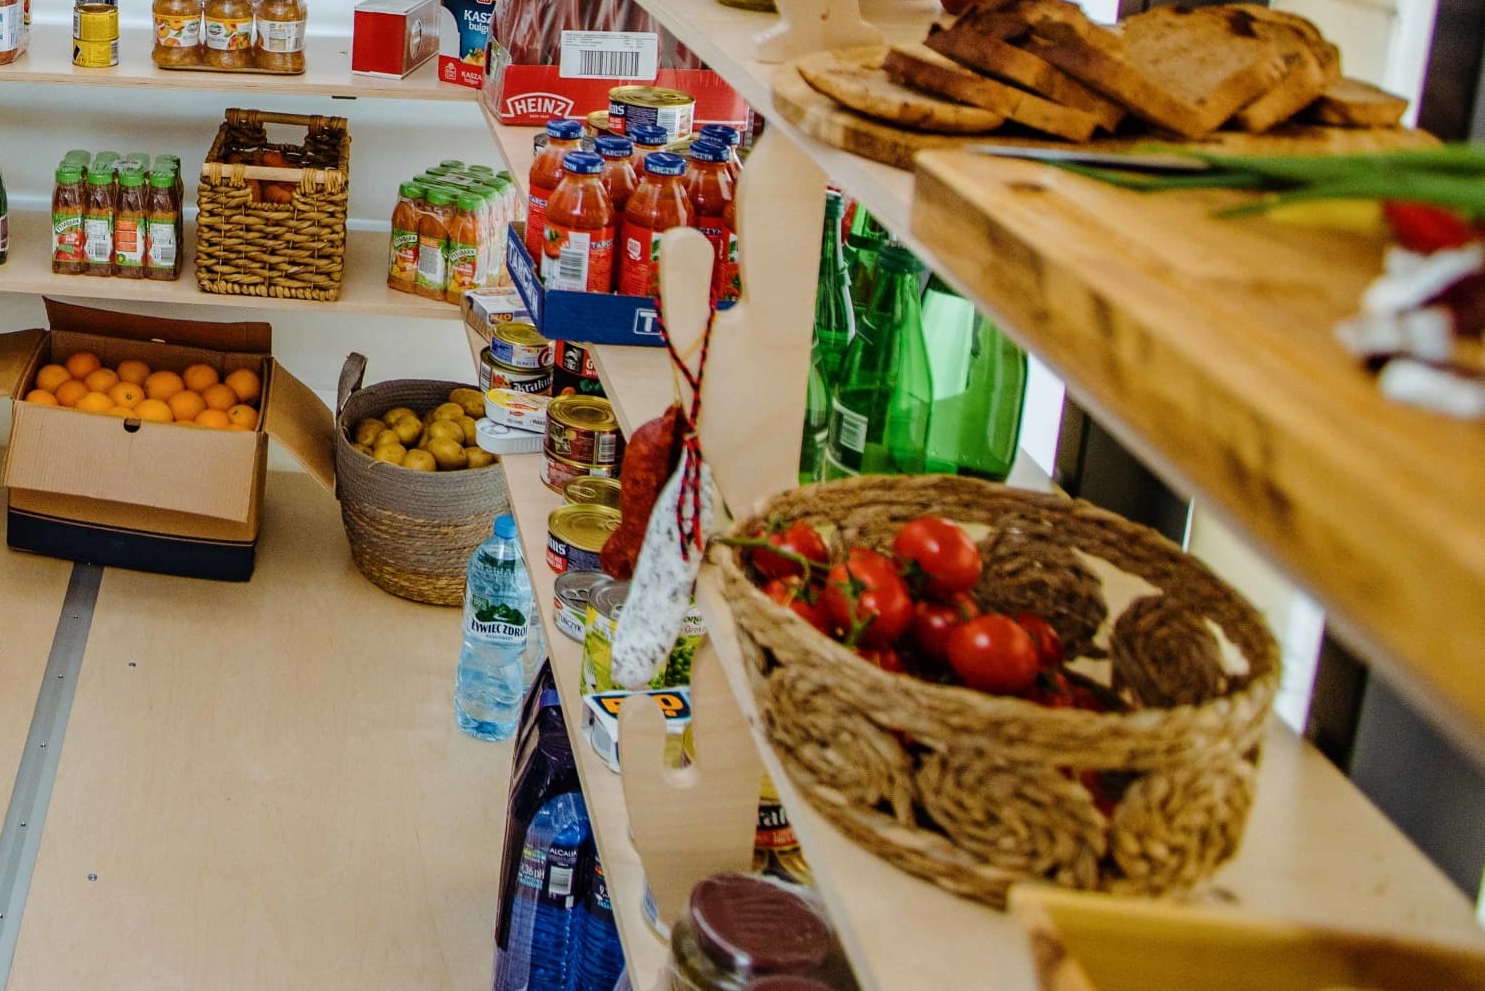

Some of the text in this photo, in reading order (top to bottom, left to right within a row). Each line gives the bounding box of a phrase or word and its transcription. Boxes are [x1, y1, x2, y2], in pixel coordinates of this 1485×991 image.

[464, 9, 492, 25] KASZ
[515, 96, 566, 116] HEINZ
[601, 146, 630, 157] TARCZYN
[648, 163, 681, 175] TARCZYN
